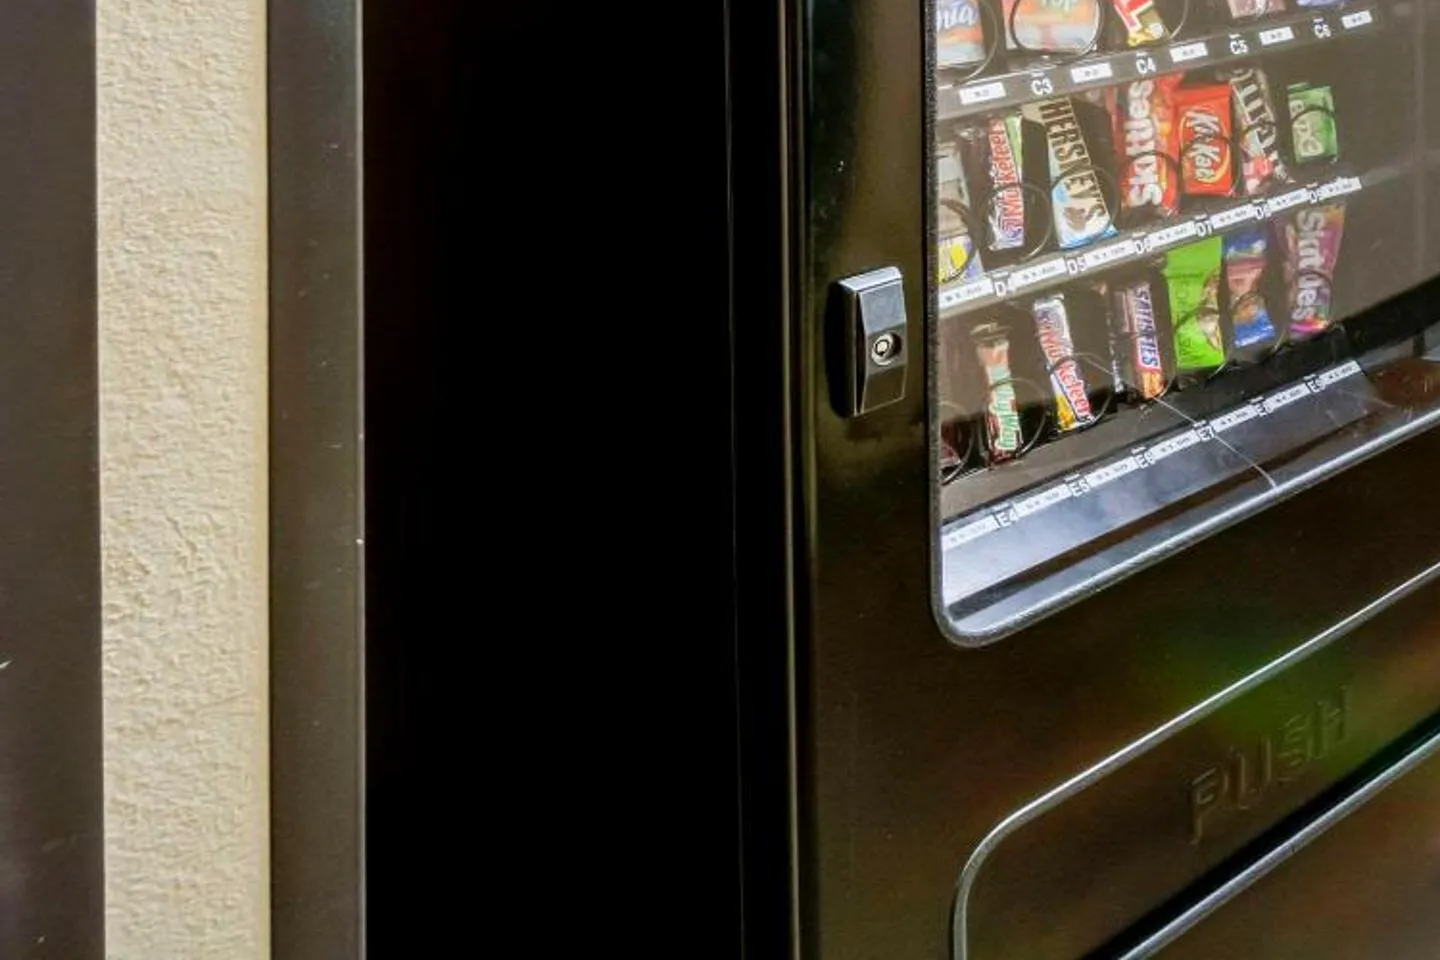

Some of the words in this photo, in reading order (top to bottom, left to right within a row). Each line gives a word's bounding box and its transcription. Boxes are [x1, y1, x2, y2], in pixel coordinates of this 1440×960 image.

[1031, 77, 1053, 95] C3
[1135, 56, 1157, 74] C4
[1038, 97, 1108, 217] HERSHEY'S
[1123, 80, 1163, 207] Skittles
[1187, 141, 1221, 180] Kat
[1292, 209, 1326, 321] Skittles
[1187, 684, 1351, 846] PUSH
